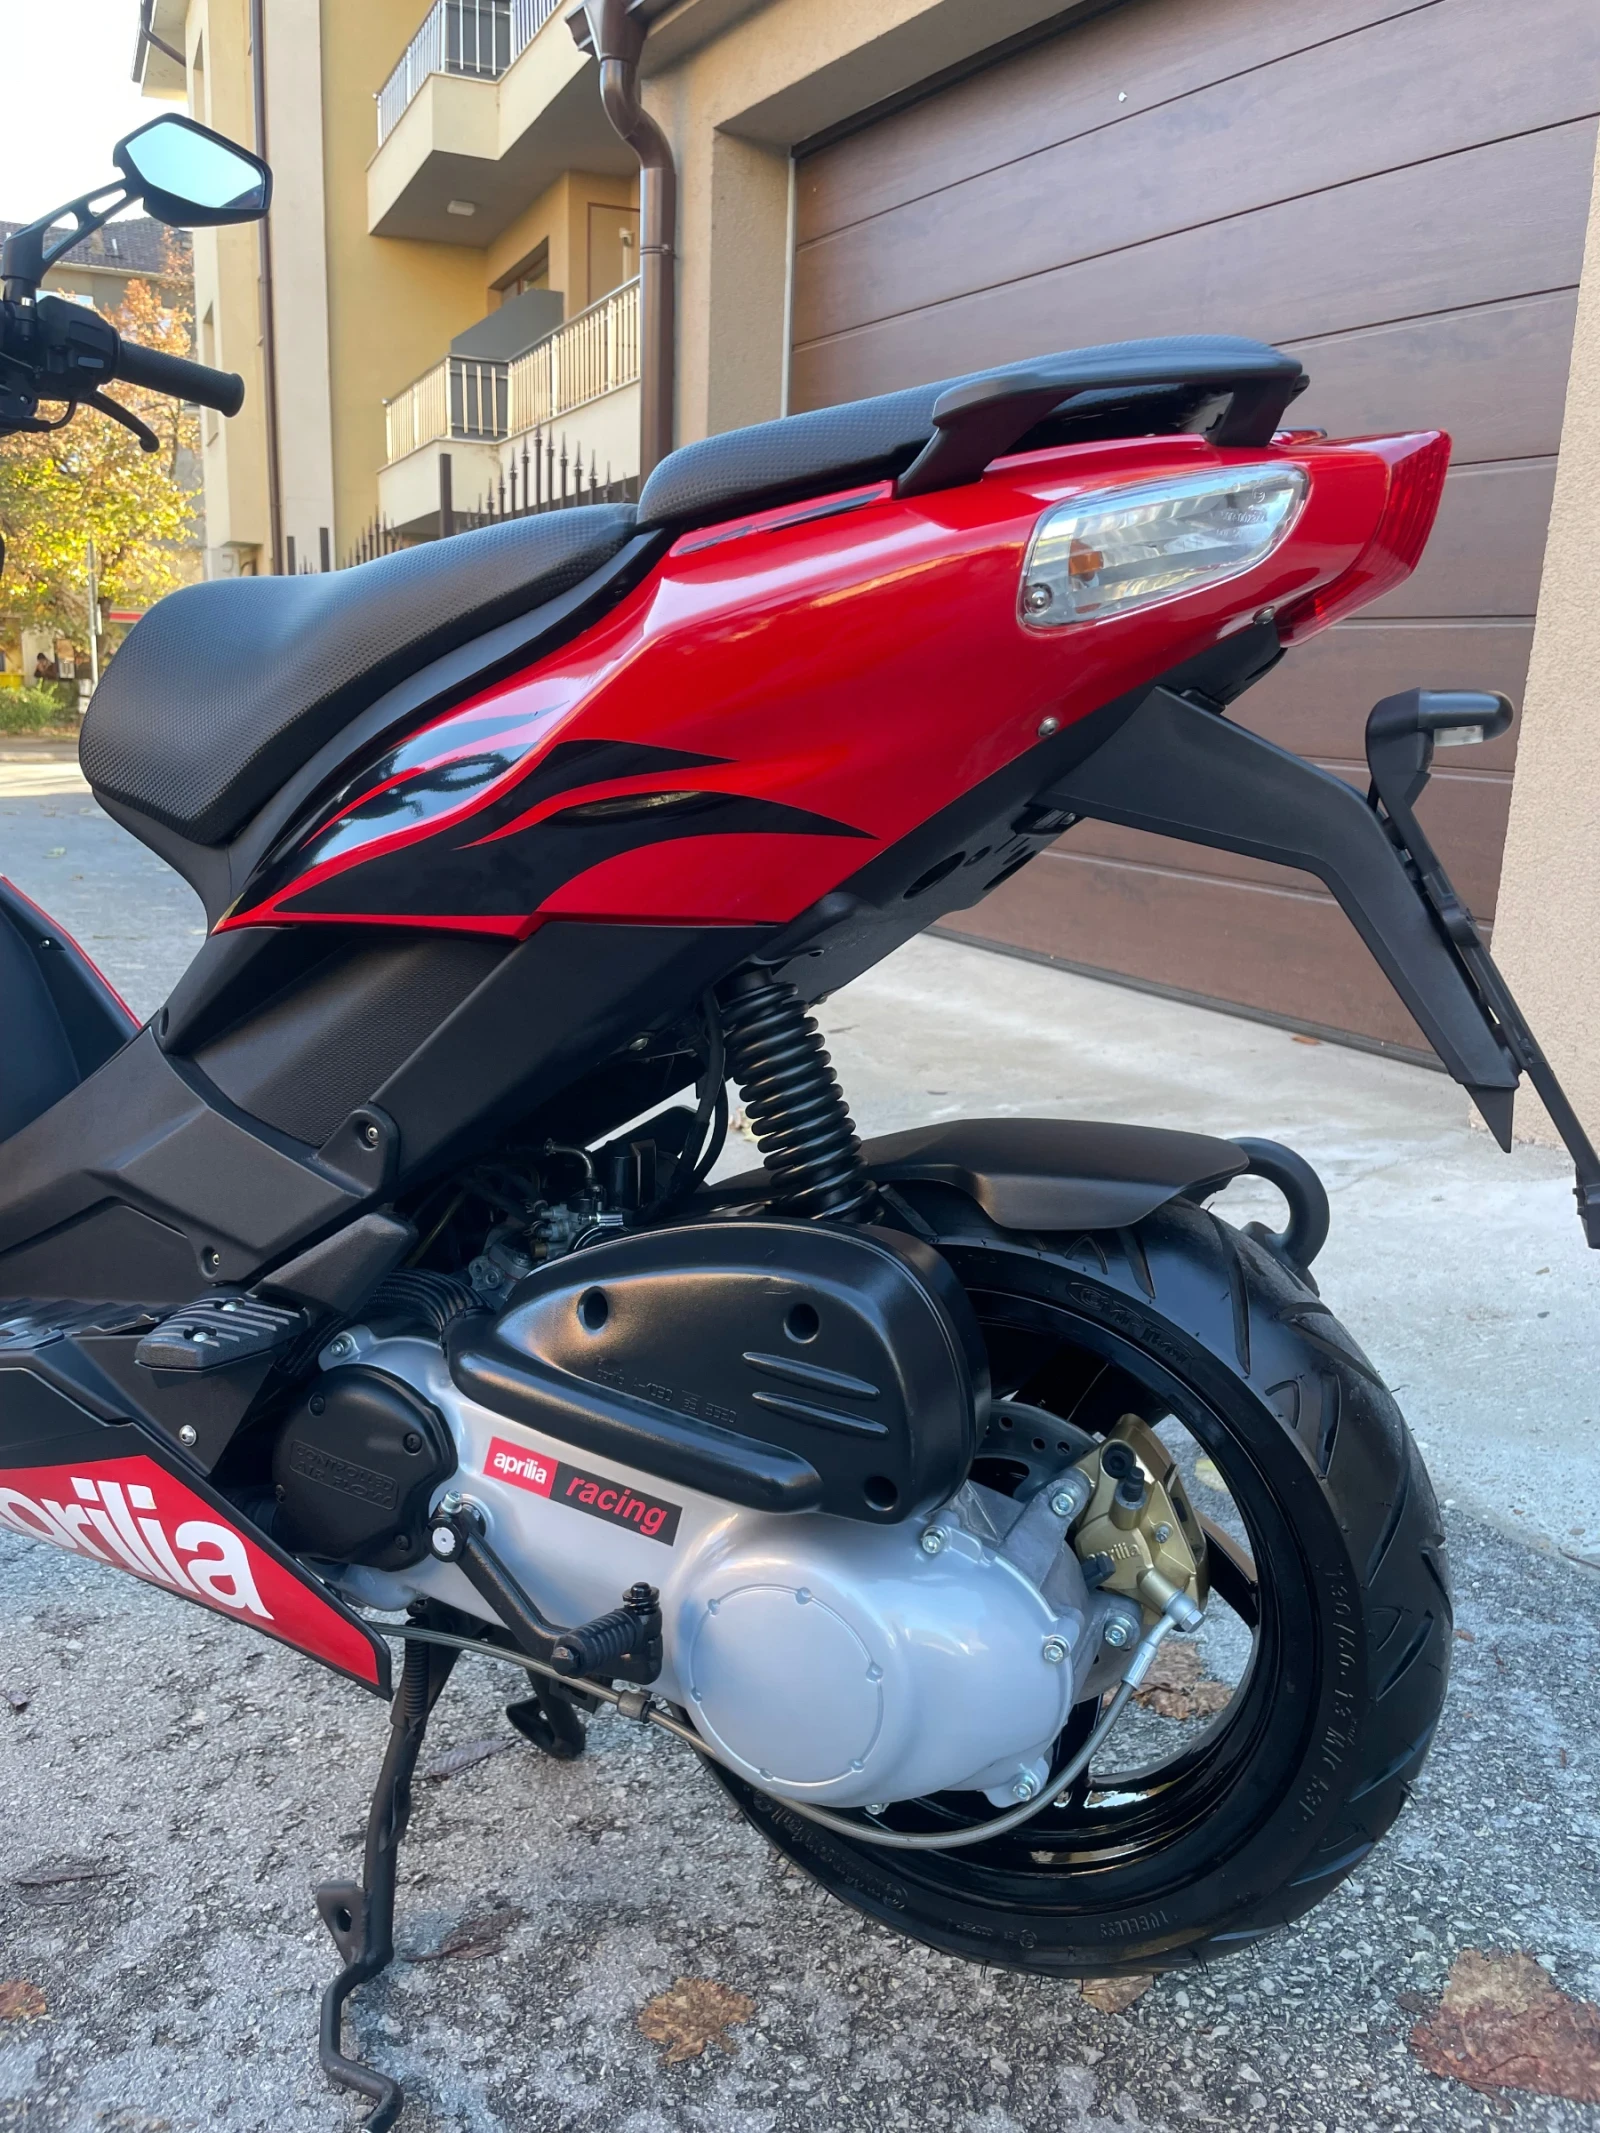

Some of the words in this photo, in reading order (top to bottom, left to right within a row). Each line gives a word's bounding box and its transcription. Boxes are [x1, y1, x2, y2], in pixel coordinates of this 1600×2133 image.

[297, 1446, 394, 1491] CONTROLLED
[493, 1451, 548, 1485] aprilia
[565, 1476, 668, 1536] racing
[0, 1477, 274, 1620] prilia
